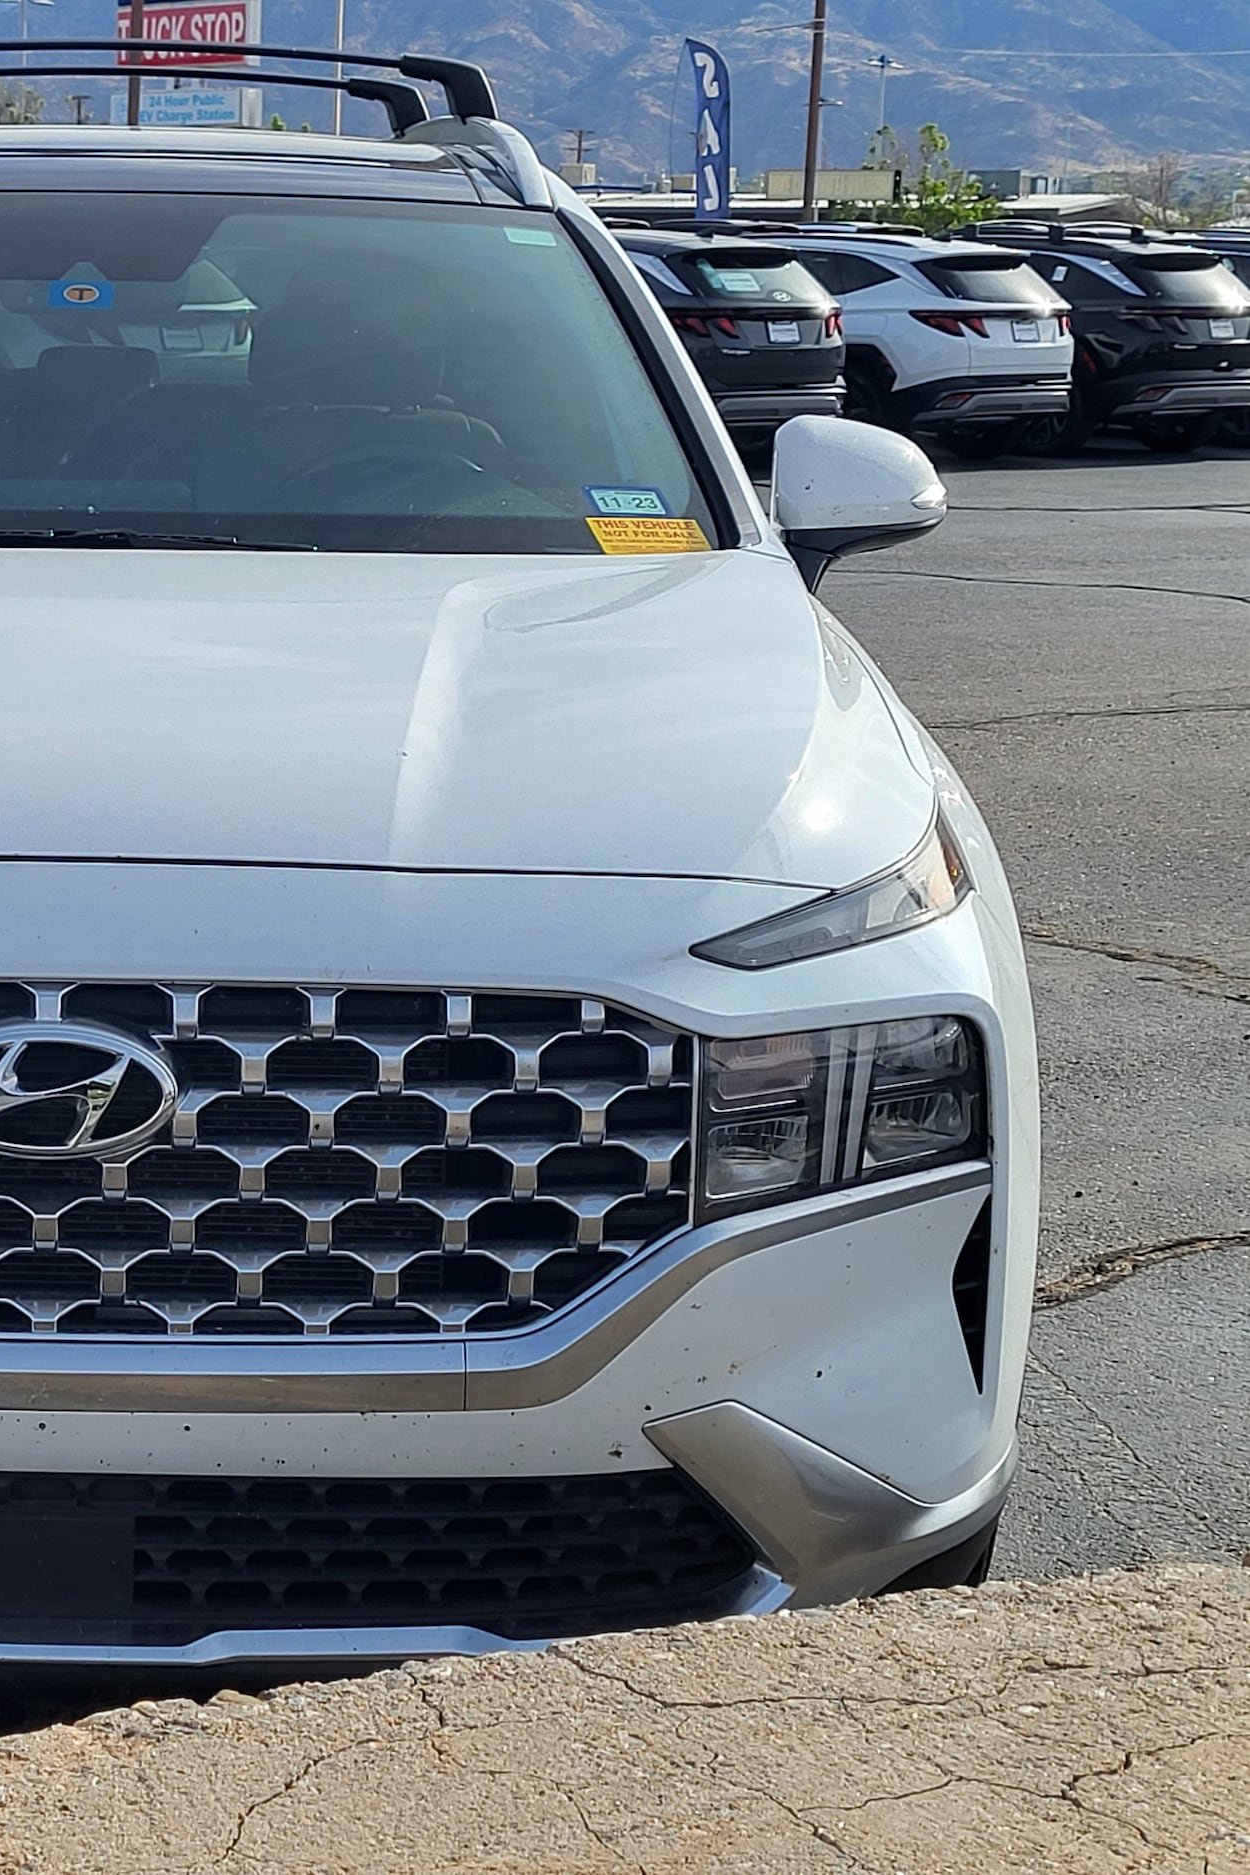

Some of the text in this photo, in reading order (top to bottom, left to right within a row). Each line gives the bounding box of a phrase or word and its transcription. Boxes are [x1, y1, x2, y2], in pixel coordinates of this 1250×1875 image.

[118, 15, 185, 61] TUCK
[148, 93, 225, 107] 24 Hour Public
[140, 109, 235, 124] EV Charge Station
[593, 519, 696, 531] THIS VEHICLE
[602, 530, 630, 538] NOT
[664, 530, 699, 539] SALE
